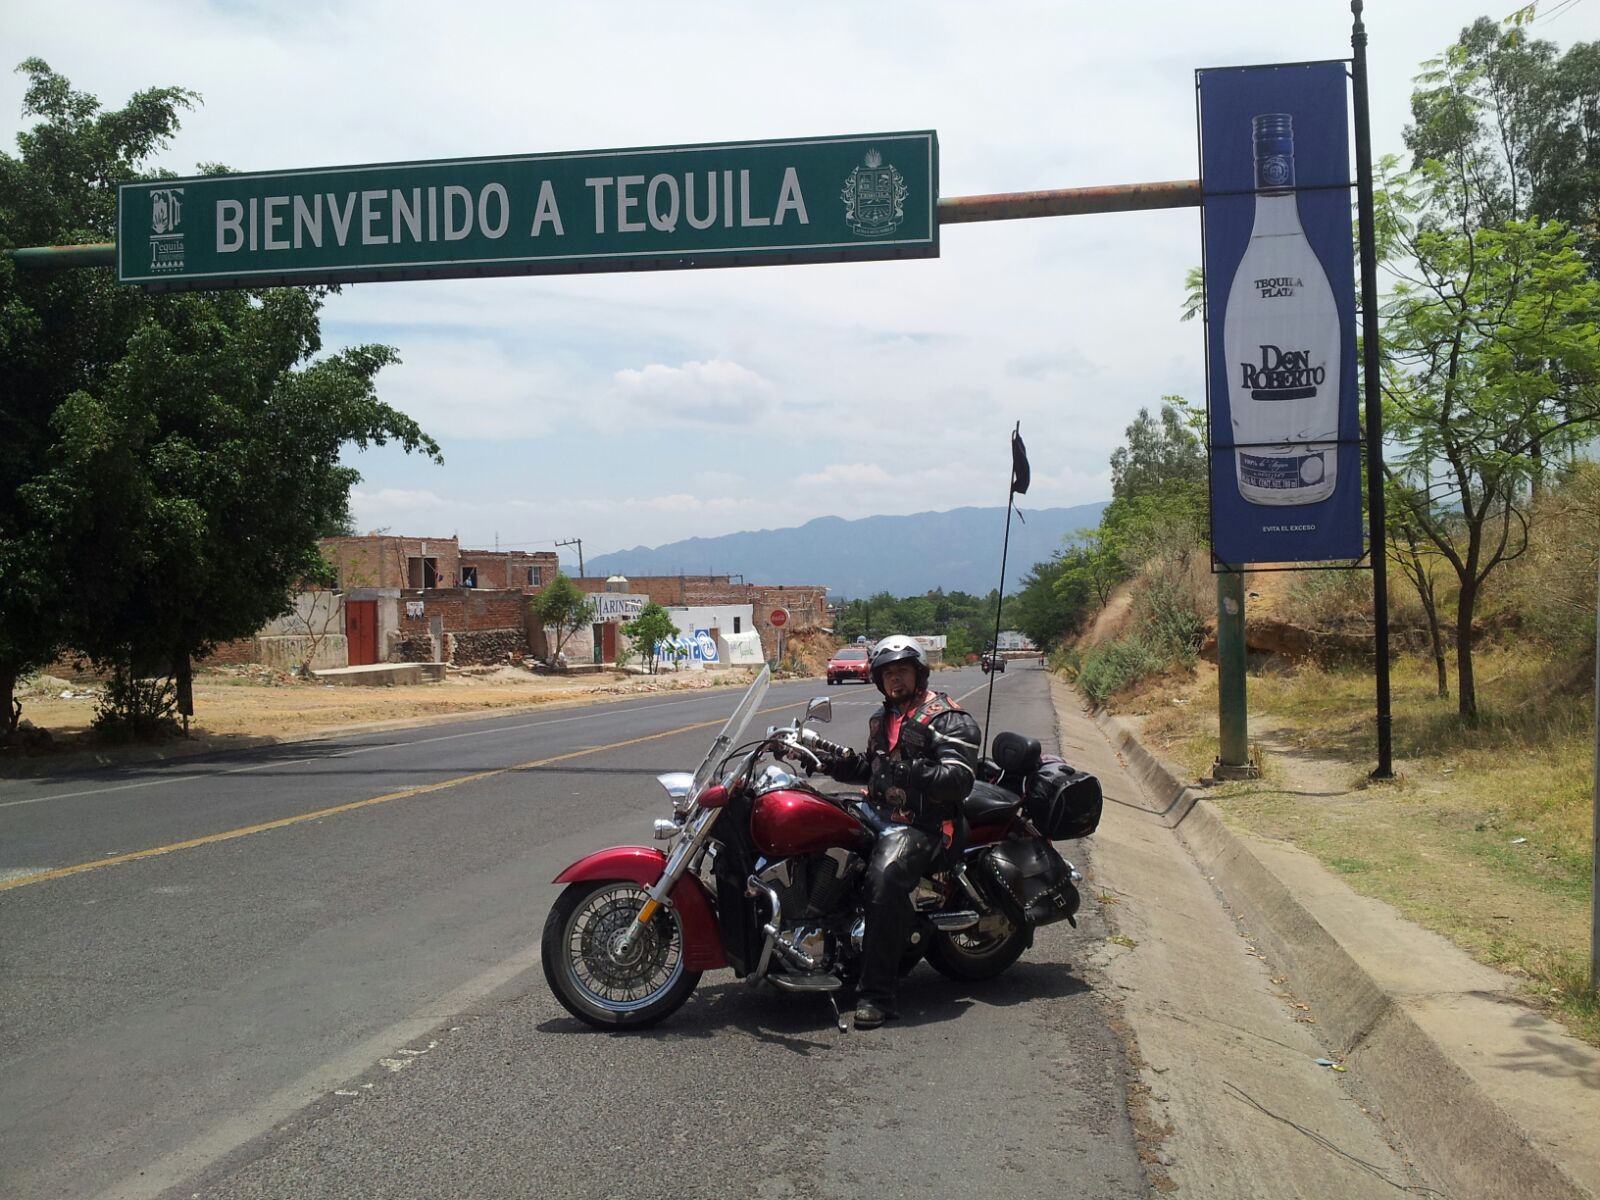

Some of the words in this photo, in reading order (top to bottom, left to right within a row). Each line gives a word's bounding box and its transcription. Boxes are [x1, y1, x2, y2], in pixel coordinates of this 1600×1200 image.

[215, 182, 510, 253] BIENVENIDO
[530, 180, 565, 237] A
[584, 166, 809, 234] TEQUILA
[150, 241, 184, 261] Tequila
[1254, 277, 1304, 289] TEQUILA
[1240, 362, 1326, 389] ROBERTO
[1289, 524, 1316, 532] EXCESO
